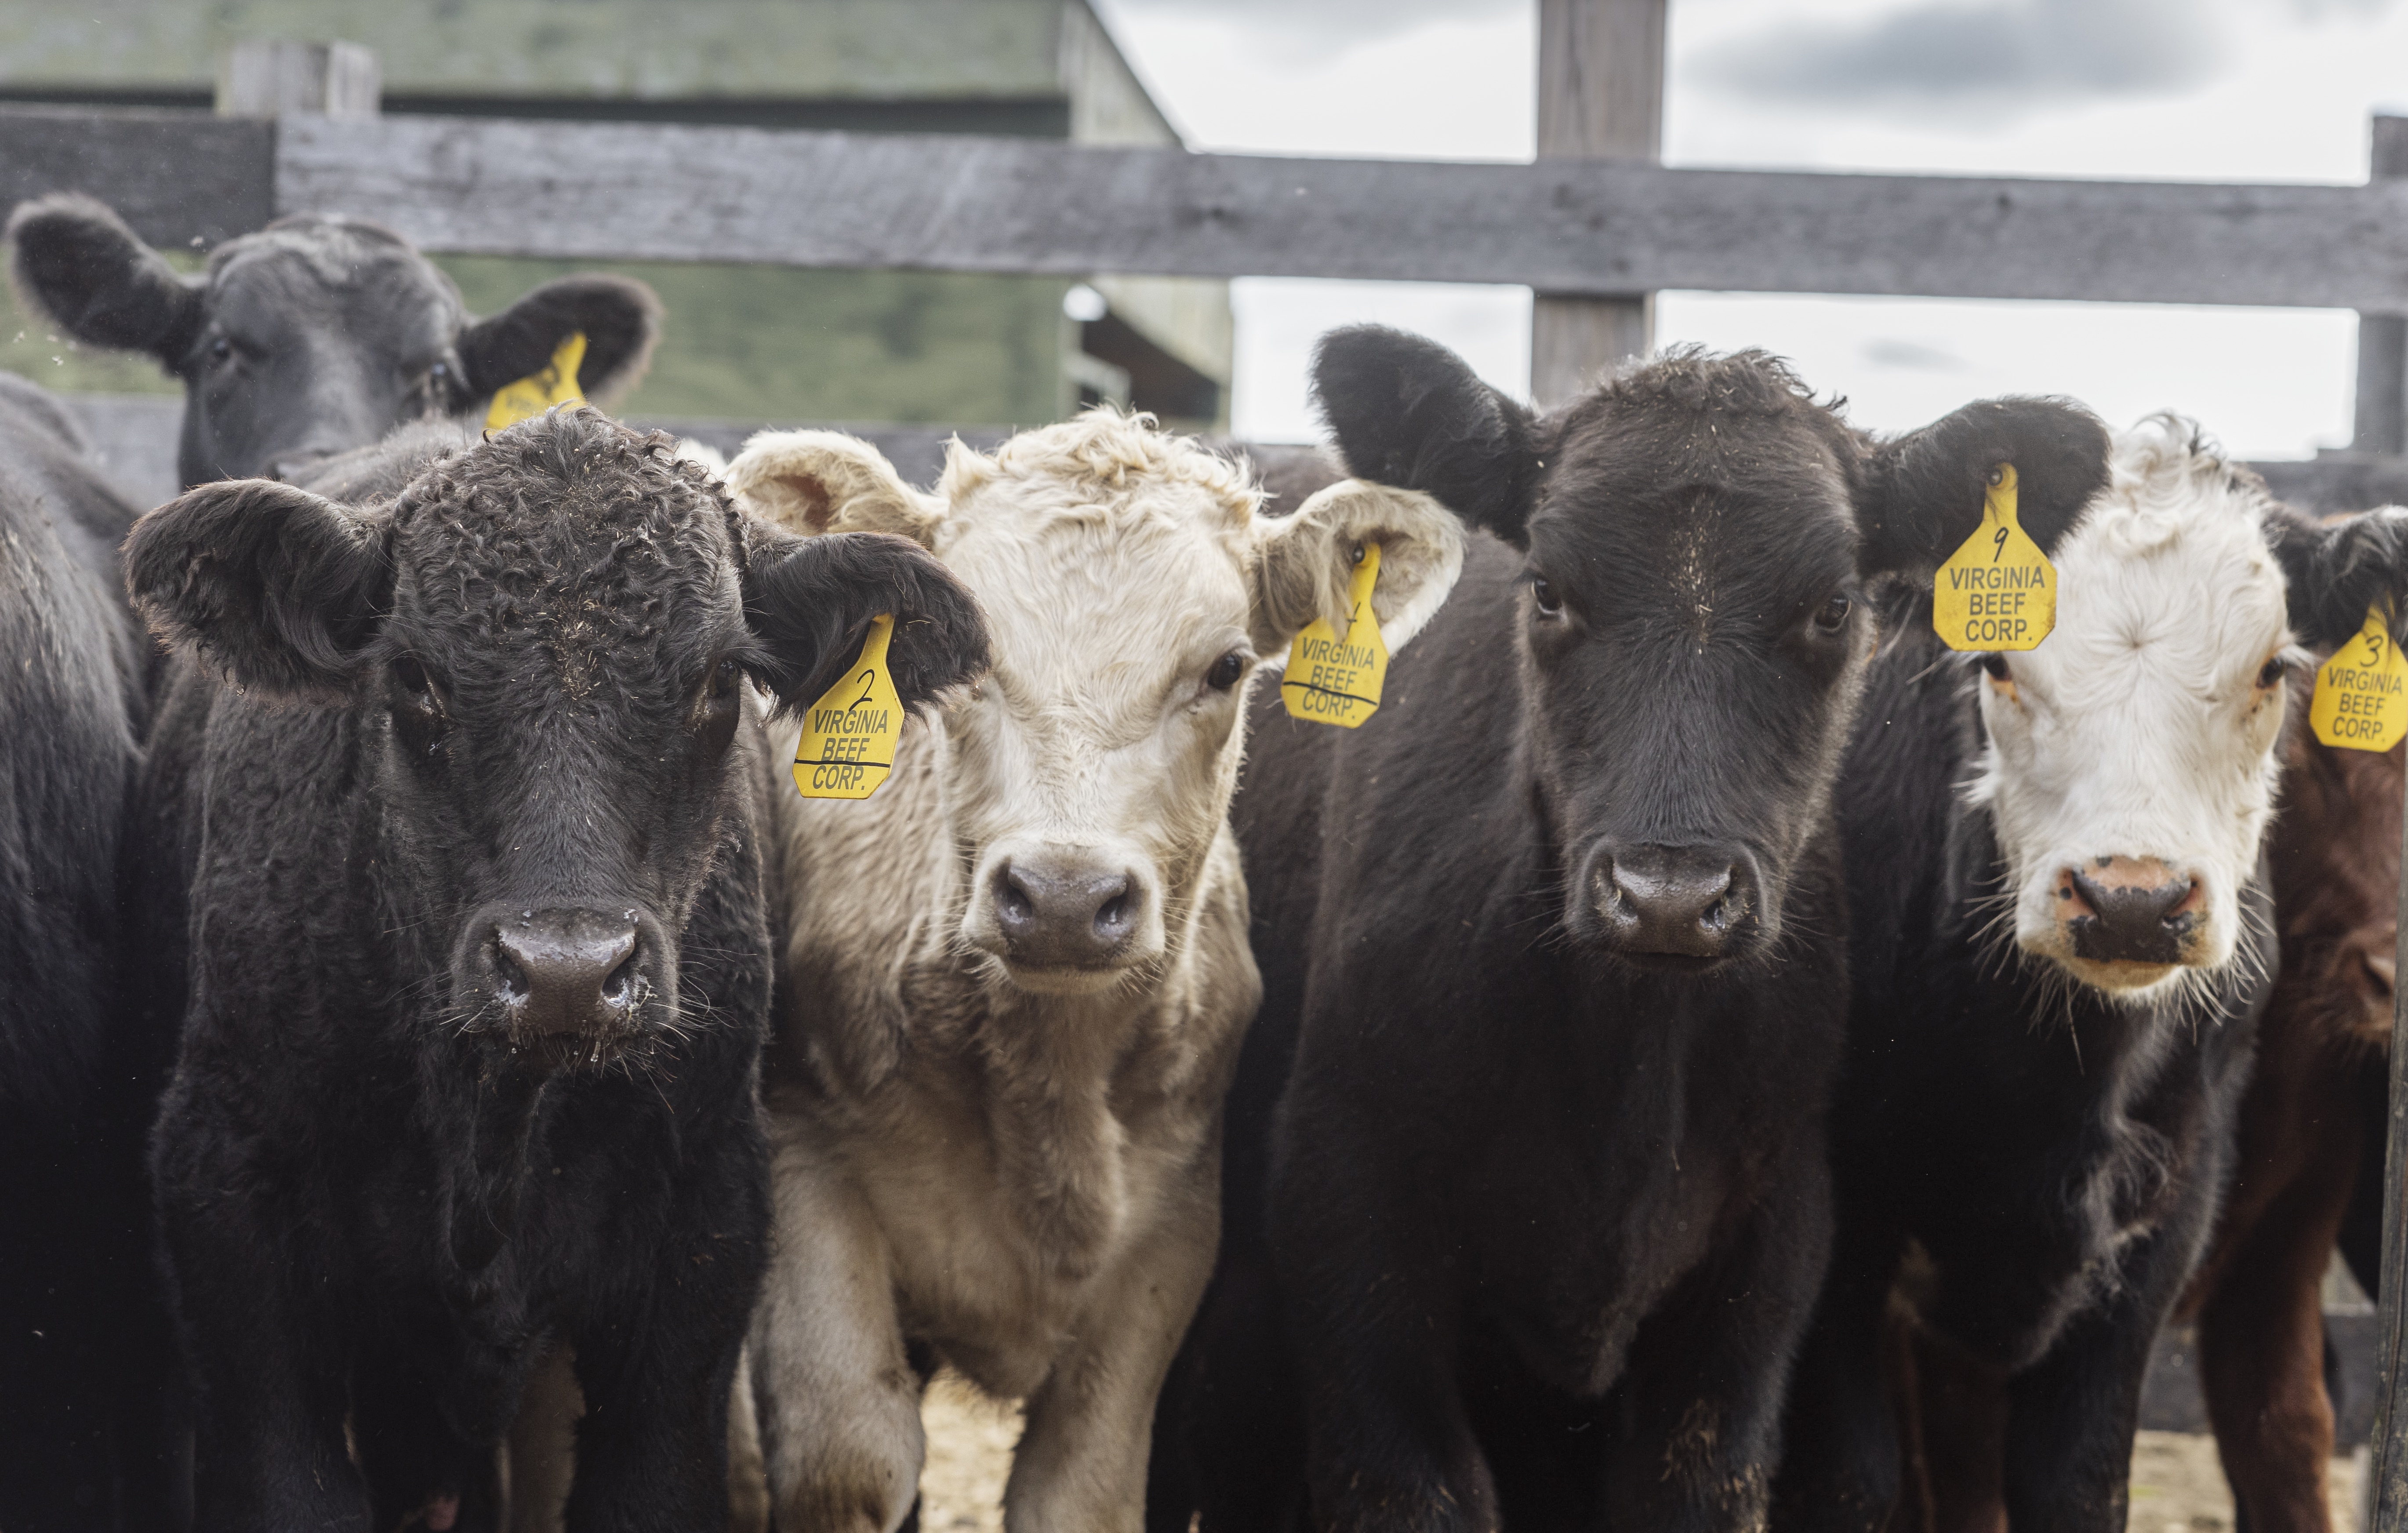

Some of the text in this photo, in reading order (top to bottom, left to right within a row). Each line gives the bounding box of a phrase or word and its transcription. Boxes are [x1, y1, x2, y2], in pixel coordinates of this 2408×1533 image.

[1994, 527, 2009, 563] 9
[1950, 566, 2045, 589] VIRGINIA
[1969, 592, 2026, 615] BEEF
[1965, 619, 2032, 641] CORP.
[1302, 637, 1374, 670] VIRGINIA
[2359, 635, 2383, 667] 3
[849, 669, 875, 712] 2
[1311, 665, 1357, 691] BEEF
[2329, 667, 2402, 695] VIRGINIA
[1302, 689, 1355, 719] CORP.
[2339, 693, 2386, 716] BEEF
[814, 709, 888, 734] VIRGINIA
[2333, 716, 2385, 742] CORP.
[821, 737, 871, 762] BEEF
[812, 765, 865, 791] CORP.
